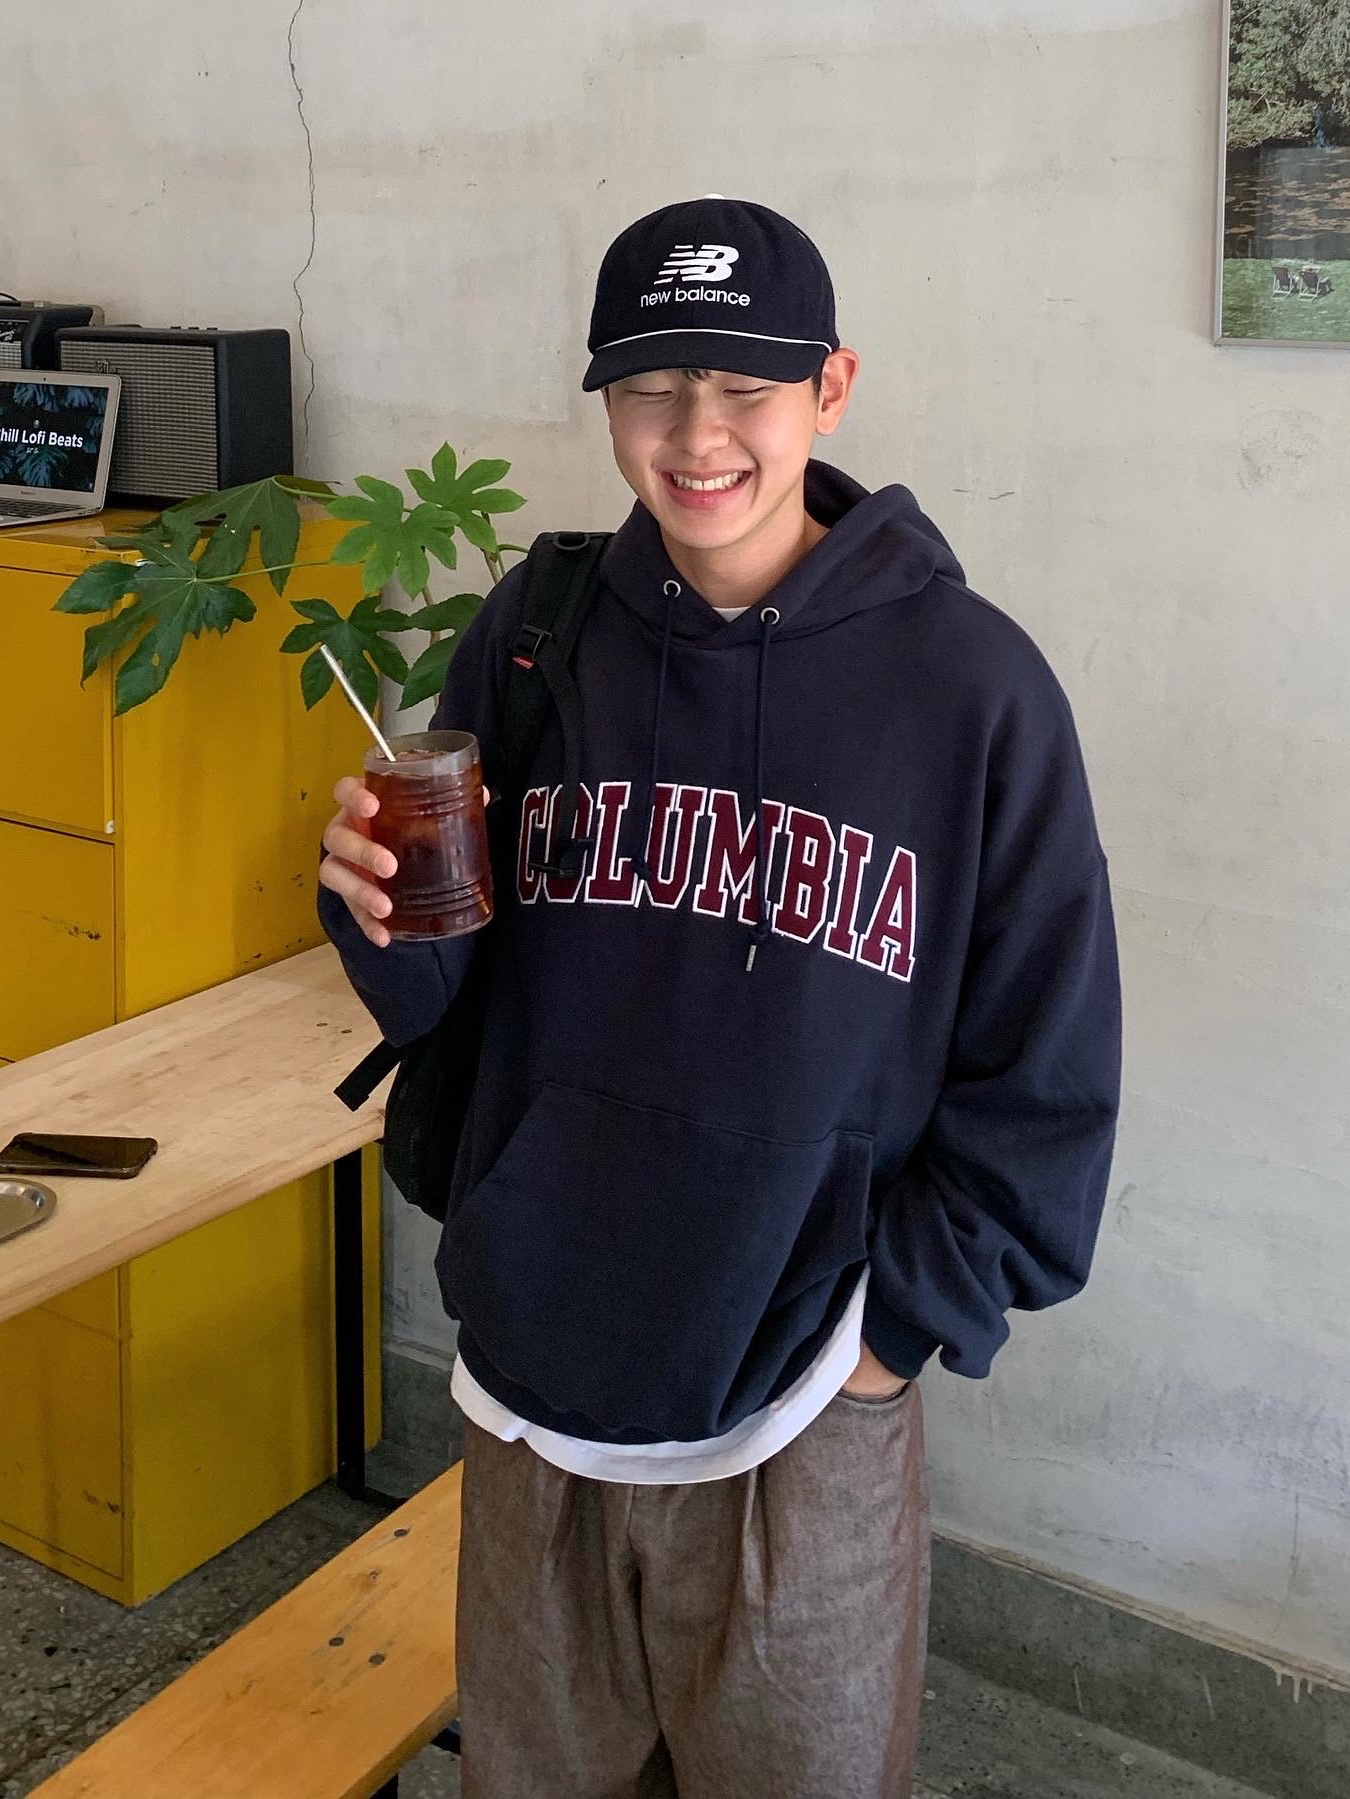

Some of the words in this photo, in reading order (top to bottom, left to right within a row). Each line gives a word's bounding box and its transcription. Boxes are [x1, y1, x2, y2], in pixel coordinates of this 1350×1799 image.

[640, 289, 671, 307] new
[675, 286, 750, 307] balance
[0, 427, 19, 443] hill
[22, 430, 46, 445] Lofi
[48, 431, 83, 448] Beats
